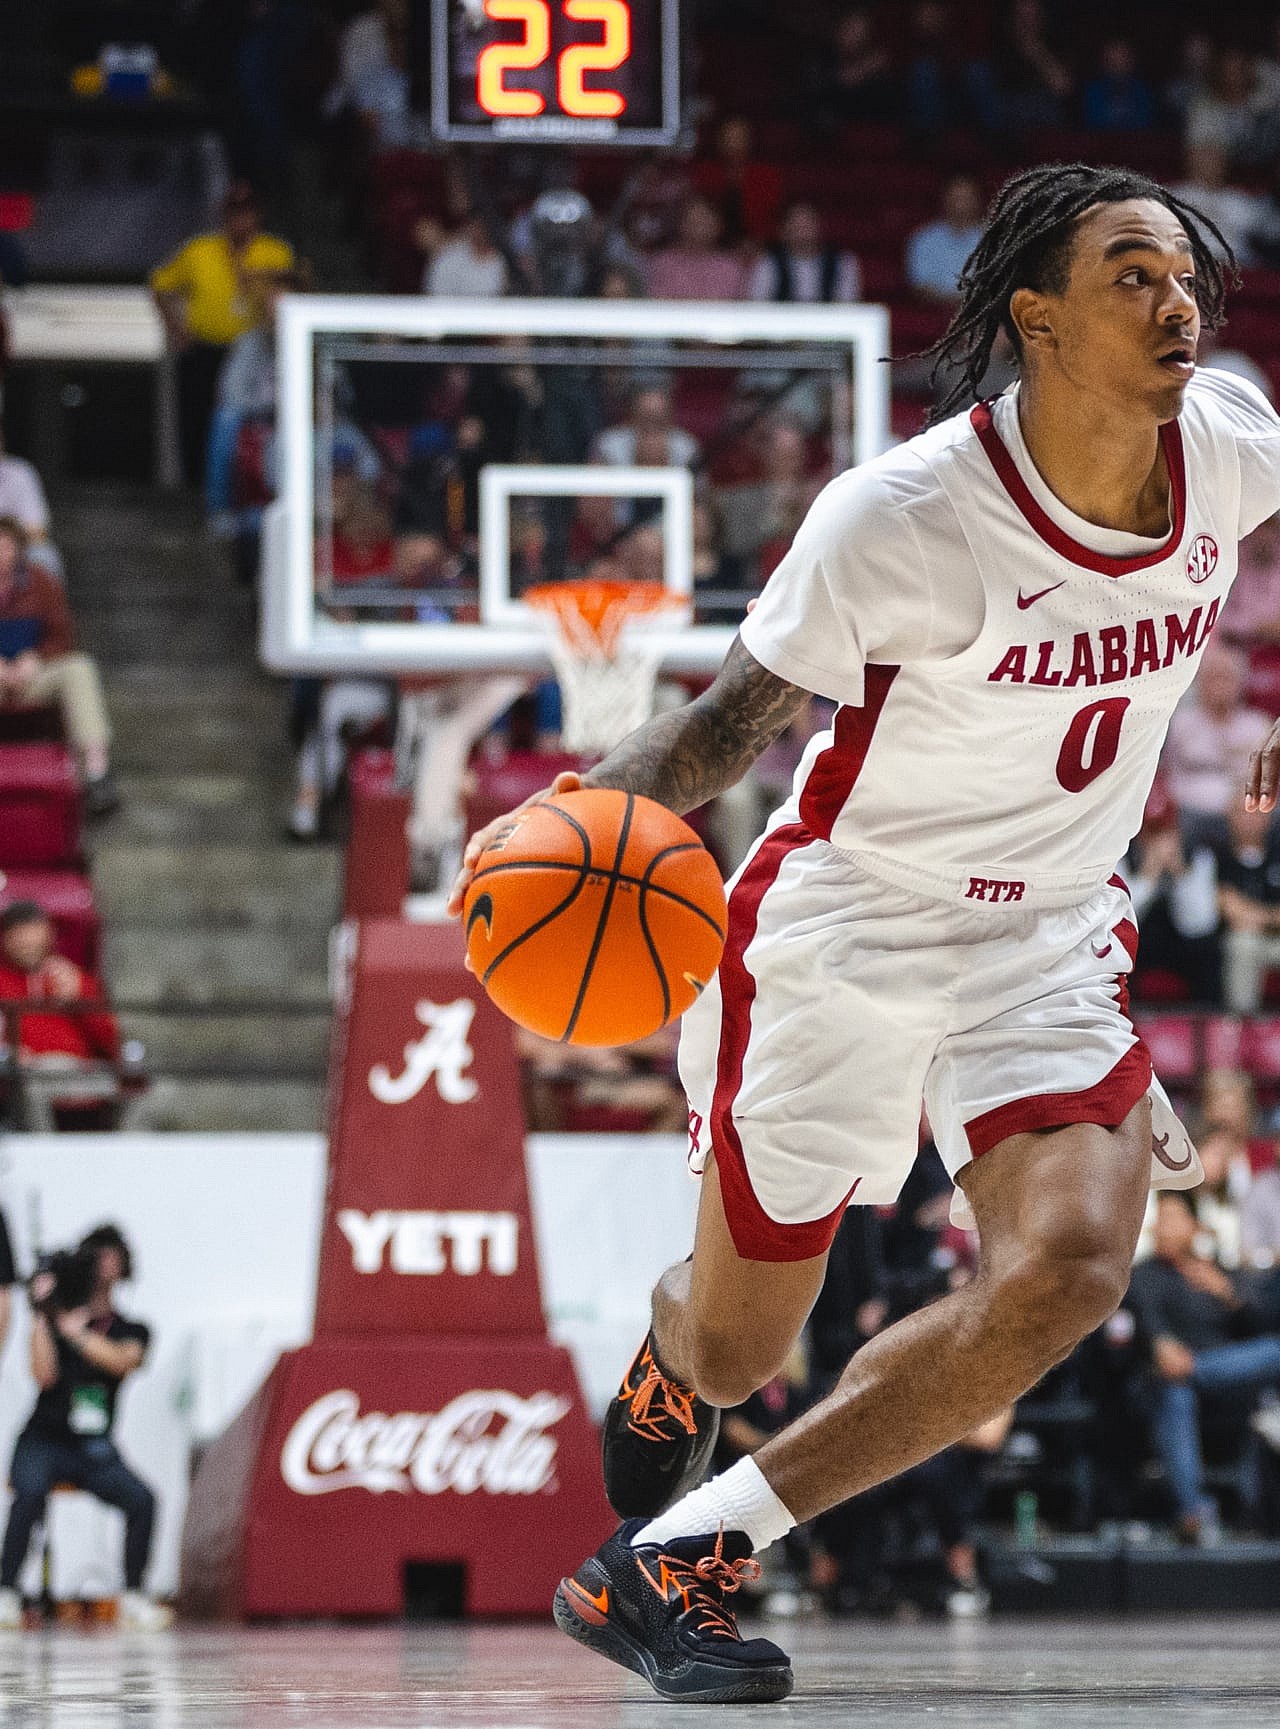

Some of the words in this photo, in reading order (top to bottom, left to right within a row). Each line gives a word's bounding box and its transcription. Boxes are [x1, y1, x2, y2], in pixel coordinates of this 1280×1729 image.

[477, 0, 631, 117] 22
[1188, 537, 1217, 582] SEC
[1056, 697, 1131, 793] 0
[964, 877, 1025, 902] RTR
[369, 998, 478, 1104] A
[337, 1209, 518, 1276] YETI
